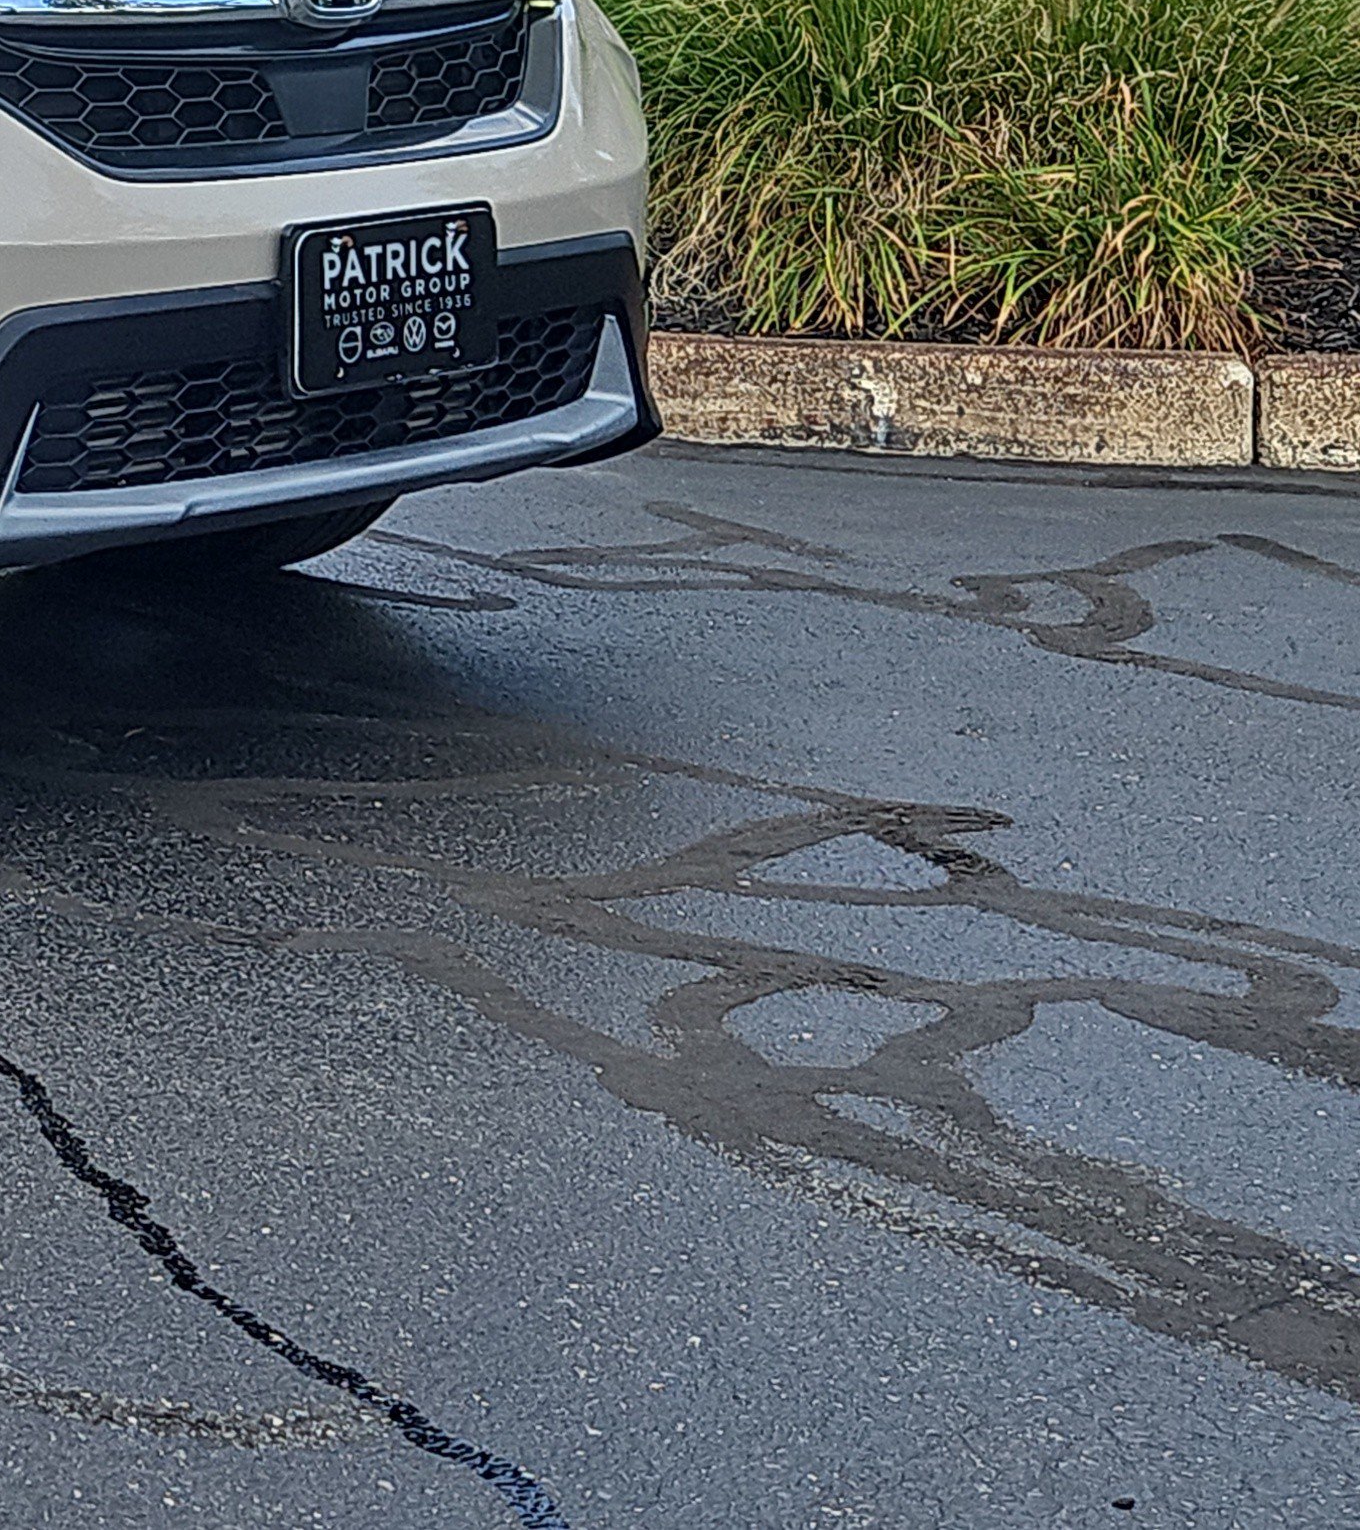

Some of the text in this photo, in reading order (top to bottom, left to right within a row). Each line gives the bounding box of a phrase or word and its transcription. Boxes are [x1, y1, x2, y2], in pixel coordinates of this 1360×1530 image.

[322, 233, 470, 290] PATRICK
[323, 273, 471, 311] MOTOR GROUP
[324, 306, 385, 329] TRUSTED
[391, 298, 433, 318] SINCE
